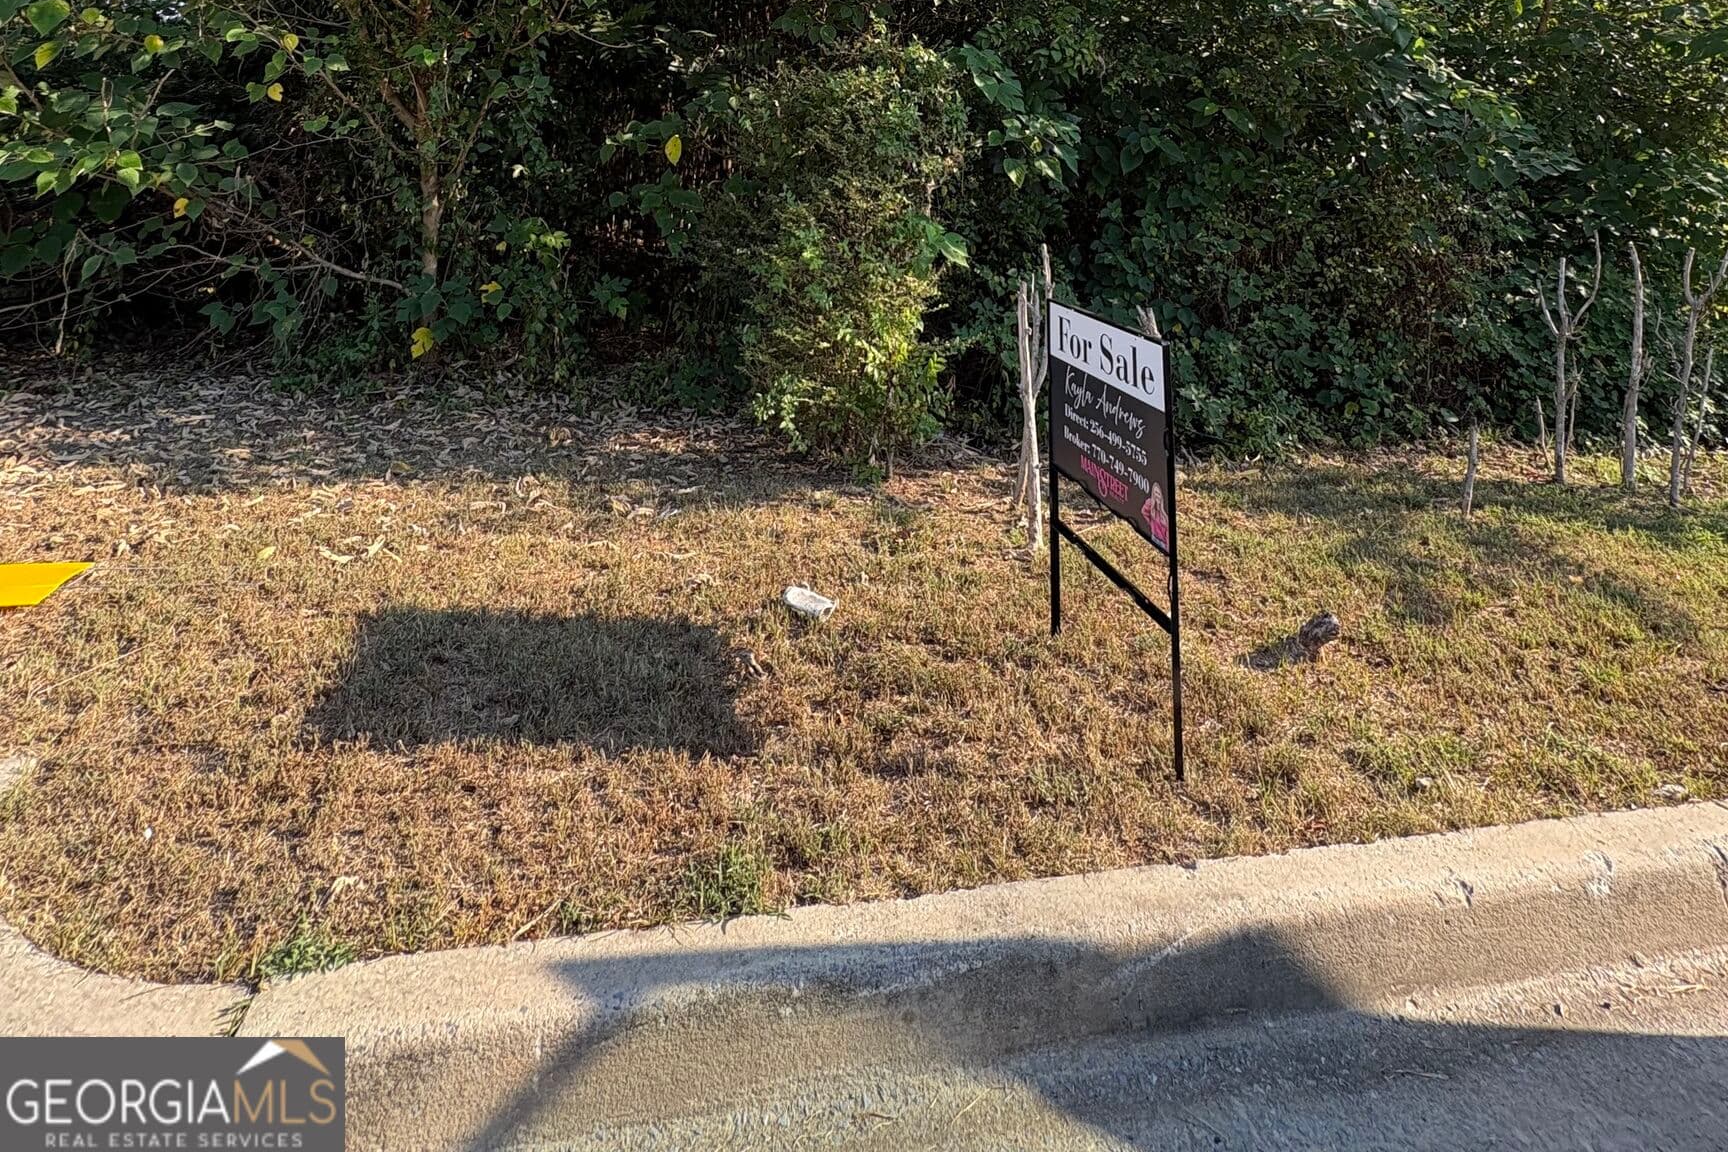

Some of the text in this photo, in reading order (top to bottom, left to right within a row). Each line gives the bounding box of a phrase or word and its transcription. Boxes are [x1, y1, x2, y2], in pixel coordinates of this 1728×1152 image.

[1058, 316, 1156, 395] For Sale
[1064, 403, 1148, 466] Direct: 256-499-5755
[1065, 365, 1146, 439] Kayla Andrews
[1064, 425, 1150, 494] Broker: 770-749-7900
